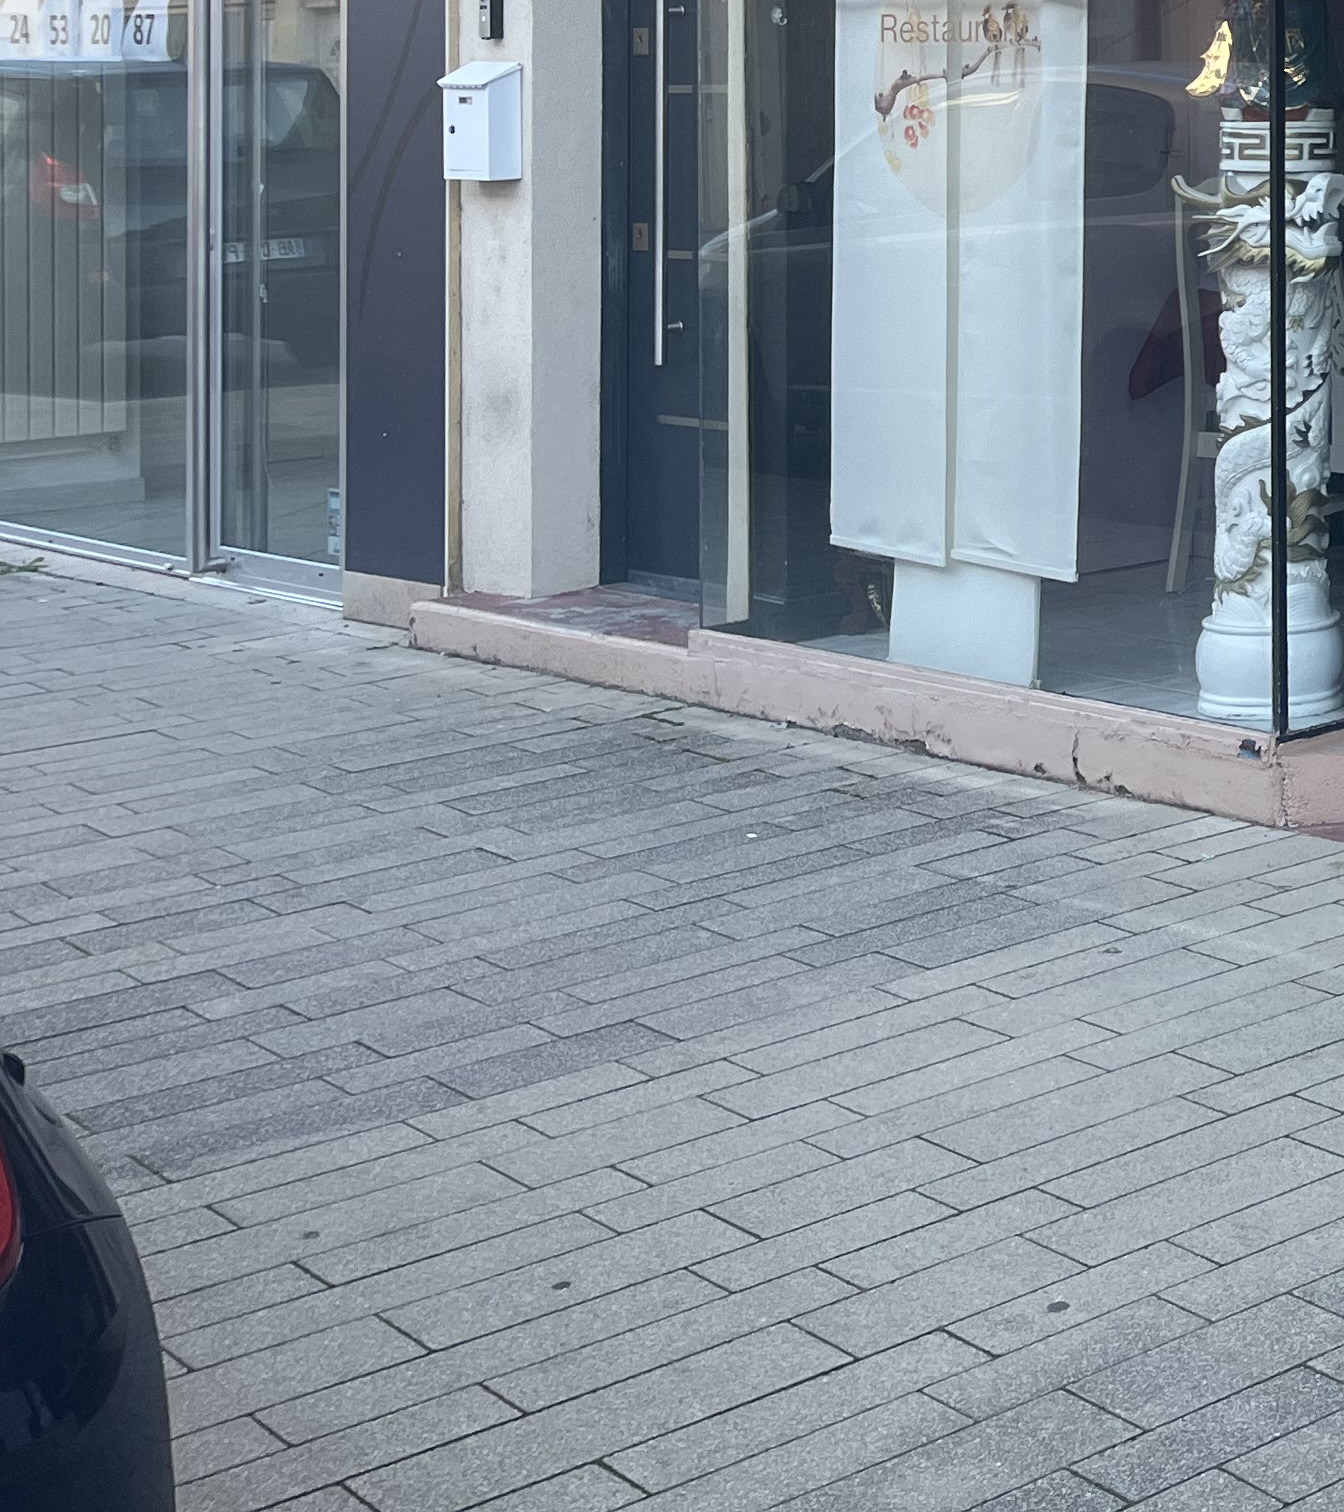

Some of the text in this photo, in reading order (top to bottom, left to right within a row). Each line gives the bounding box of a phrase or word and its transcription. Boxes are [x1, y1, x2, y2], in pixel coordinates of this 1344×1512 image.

[9, 13, 155, 46] 24 53 20 87
